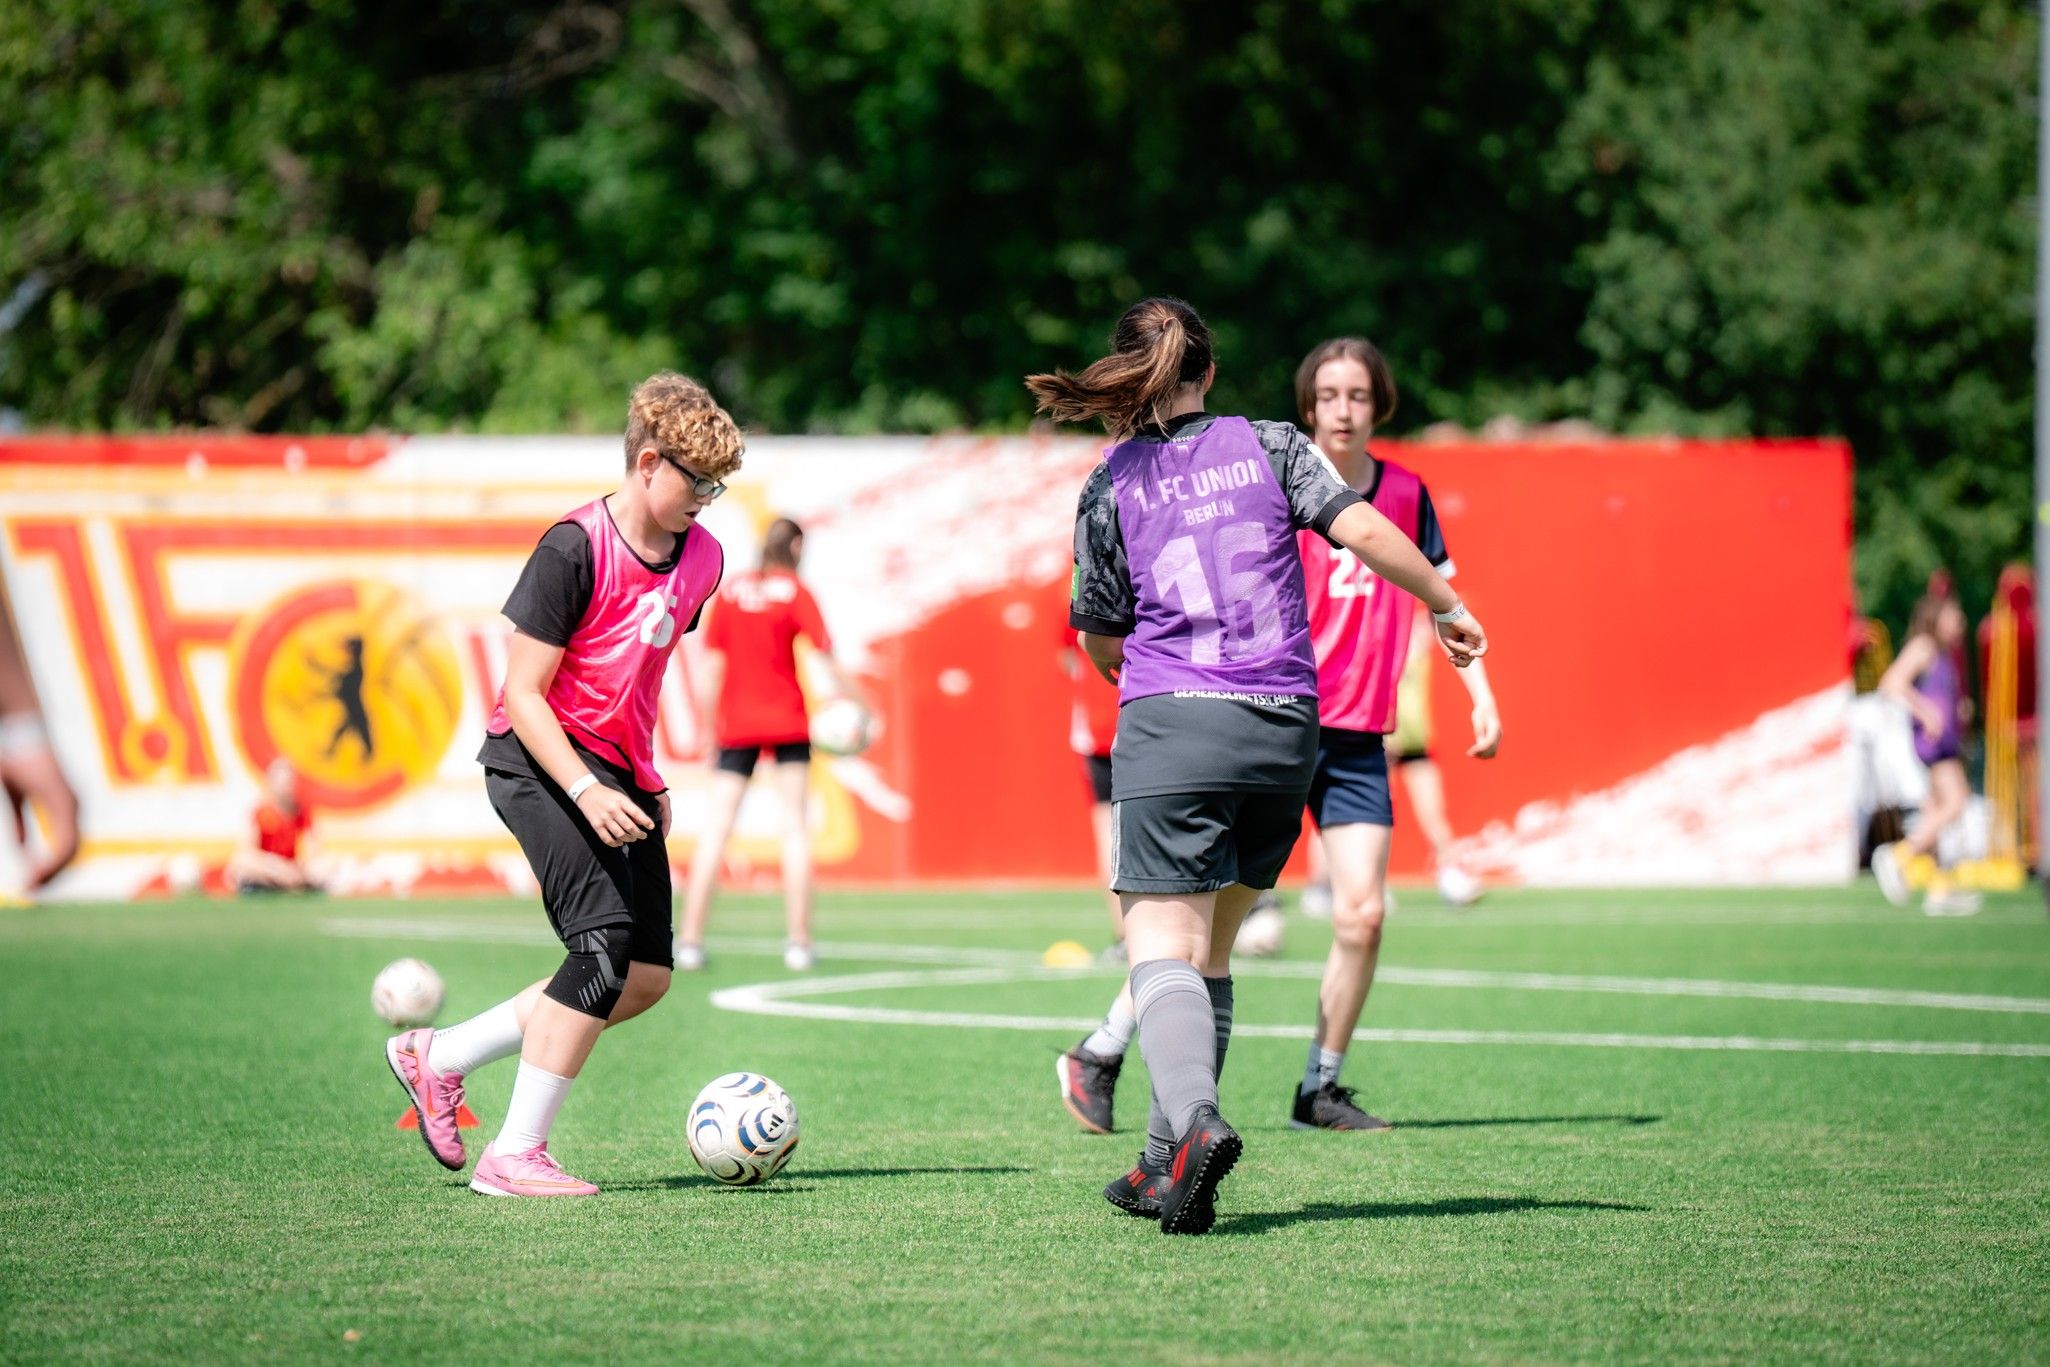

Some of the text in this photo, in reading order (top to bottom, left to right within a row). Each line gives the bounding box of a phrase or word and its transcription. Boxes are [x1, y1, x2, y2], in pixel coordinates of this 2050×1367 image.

[1133, 458, 1265, 513] 1. FC UNION
[1183, 499, 1236, 527] BERLIN
[1150, 521, 1284, 665] 16
